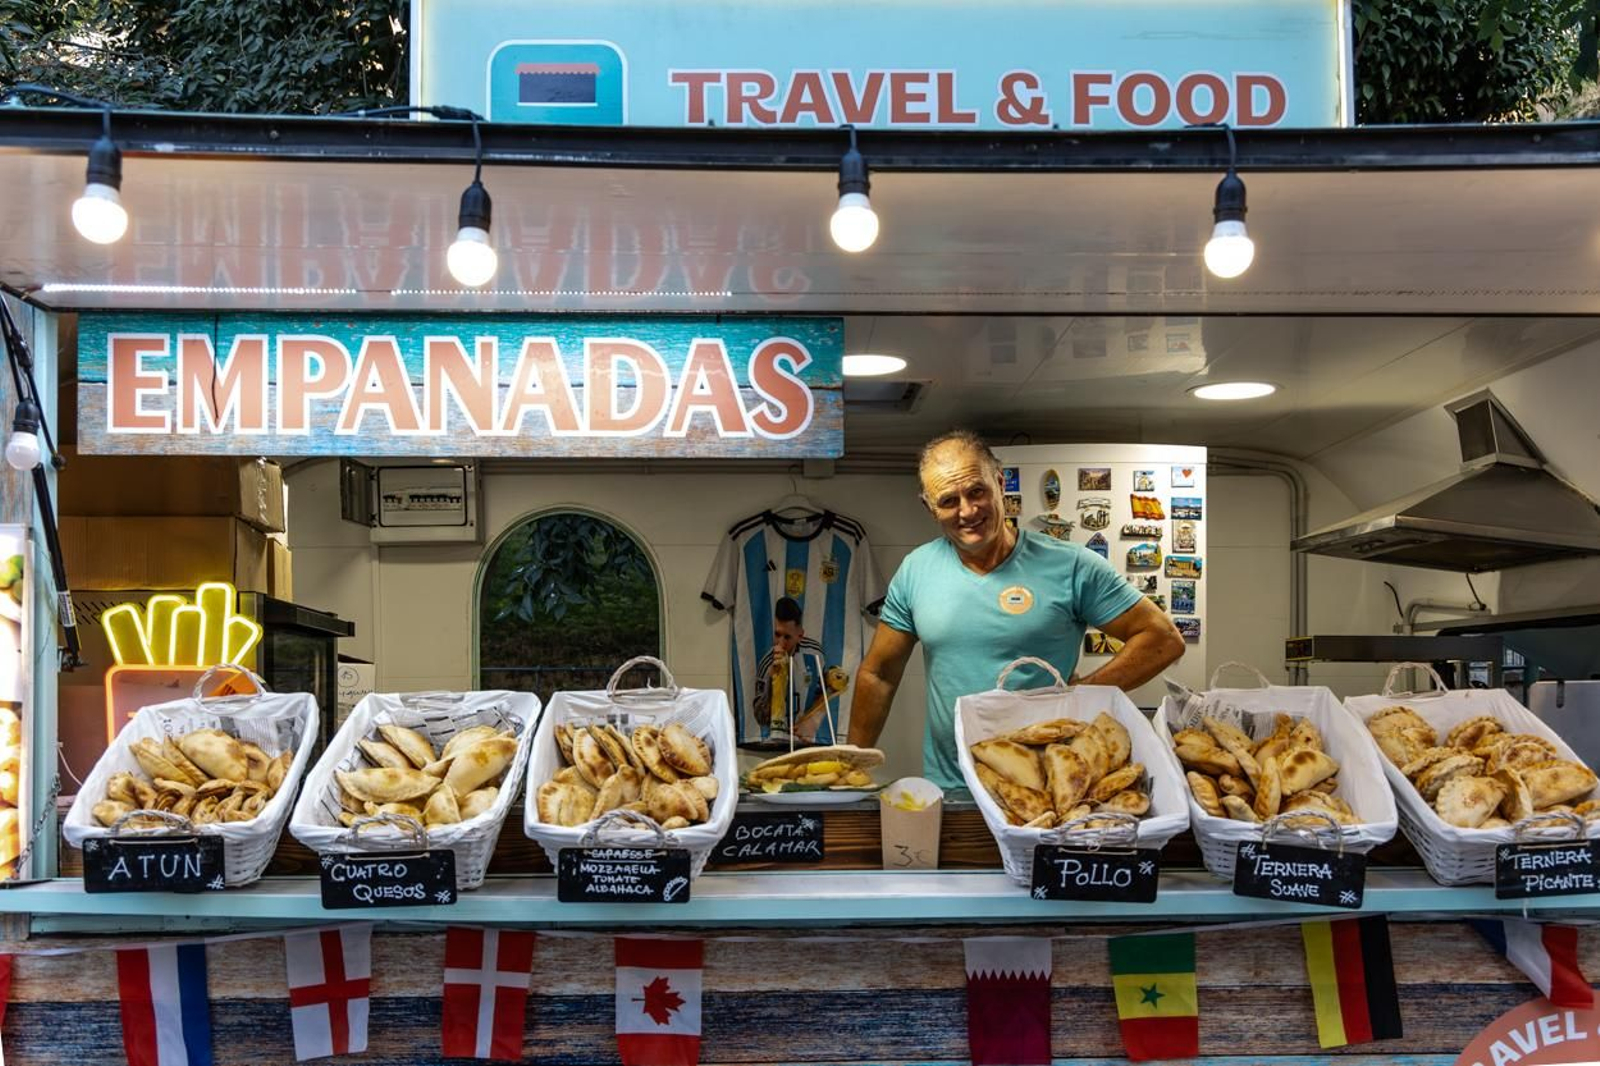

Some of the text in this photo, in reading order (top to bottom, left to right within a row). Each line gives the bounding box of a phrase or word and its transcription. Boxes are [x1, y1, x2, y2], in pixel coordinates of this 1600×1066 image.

[667, 67, 1290, 127] TRAVEL & FOOD
[106, 333, 814, 440] EMPANADAS
[735, 824, 804, 839] BOCATA
[722, 841, 822, 857] CALAMAR
[107, 854, 202, 880] ATUN
[580, 863, 661, 875] MOZZARELLA
[1250, 855, 1333, 879] TERNERA
[1509, 849, 1593, 870] TERNERA
[331, 863, 408, 882] CUATRO
[592, 874, 641, 884] TOMATE
[585, 883, 654, 895] ALBAHACA
[1270, 878, 1320, 897] SUAVE
[1520, 873, 1595, 892] PICANTE
[353, 883, 426, 903] QUESOS
[1471, 1011, 1588, 1066] AVEL
